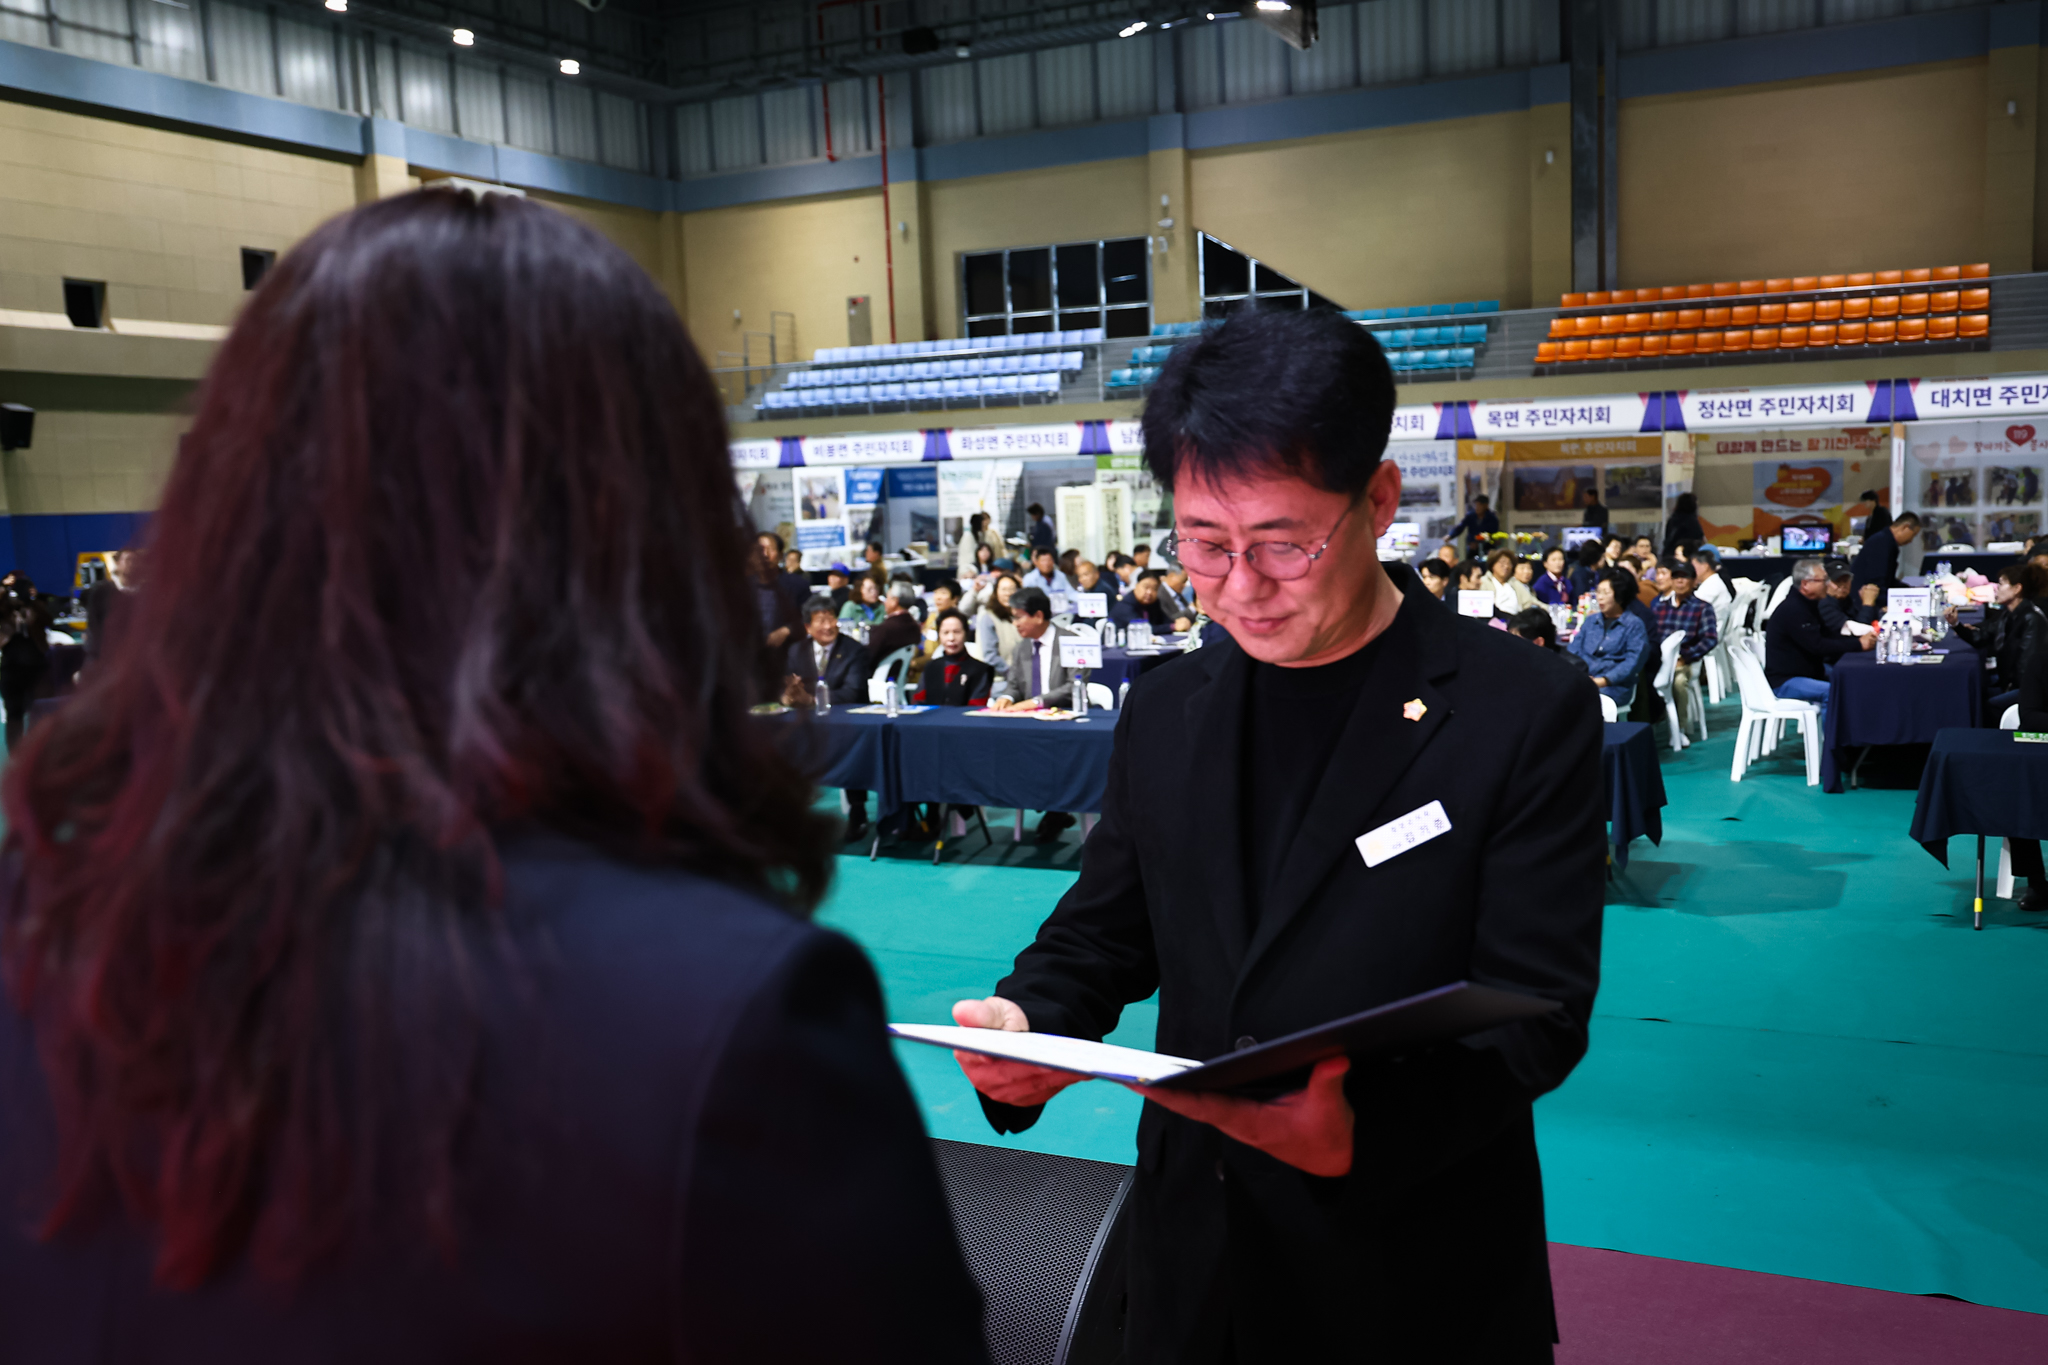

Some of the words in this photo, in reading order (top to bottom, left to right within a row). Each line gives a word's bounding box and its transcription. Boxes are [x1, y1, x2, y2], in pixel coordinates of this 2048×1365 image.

[1698, 397, 1753, 419] 정산면
[1758, 393, 1855, 416] 주민자치회
[1930, 386, 1992, 408] 대치면
[1487, 409, 1520, 427] 목면
[1525, 405, 1612, 427] 주민자치회
[852, 439, 914, 456] 주민자치회
[1003, 432, 1069, 449] 주민자치회
